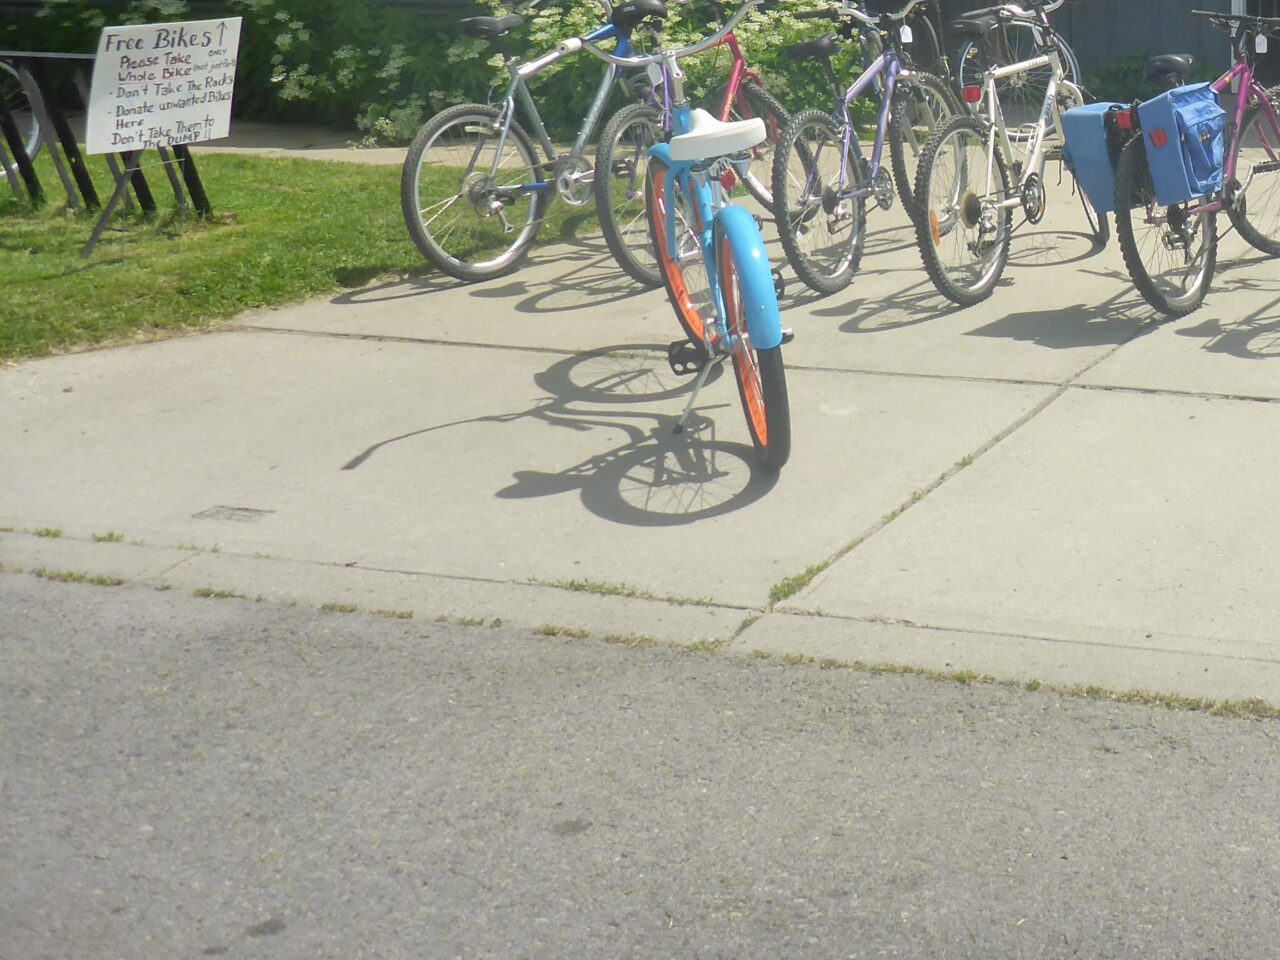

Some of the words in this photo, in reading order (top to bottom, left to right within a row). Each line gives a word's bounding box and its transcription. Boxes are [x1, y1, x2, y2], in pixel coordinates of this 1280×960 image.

[104, 34, 144, 52] Free
[152, 26, 212, 49] Bikes
[120, 55, 160, 69] Please
[164, 51, 192, 65] Take
[118, 71, 156, 82] Whole
[162, 67, 192, 80] Bike
[116, 85, 148, 98] Don't
[154, 83, 182, 96] Take
[187, 80, 202, 91] The
[205, 73, 234, 88] Racks
[115, 101, 154, 117] Donate
[159, 92, 206, 111] unwanted
[208, 90, 232, 102] Bikes
[116, 119, 144, 130] Here
[148, 126, 171, 138] Take
[176, 120, 201, 133] Them
[203, 114, 215, 128] to
[168, 131, 200, 145] DUMP
